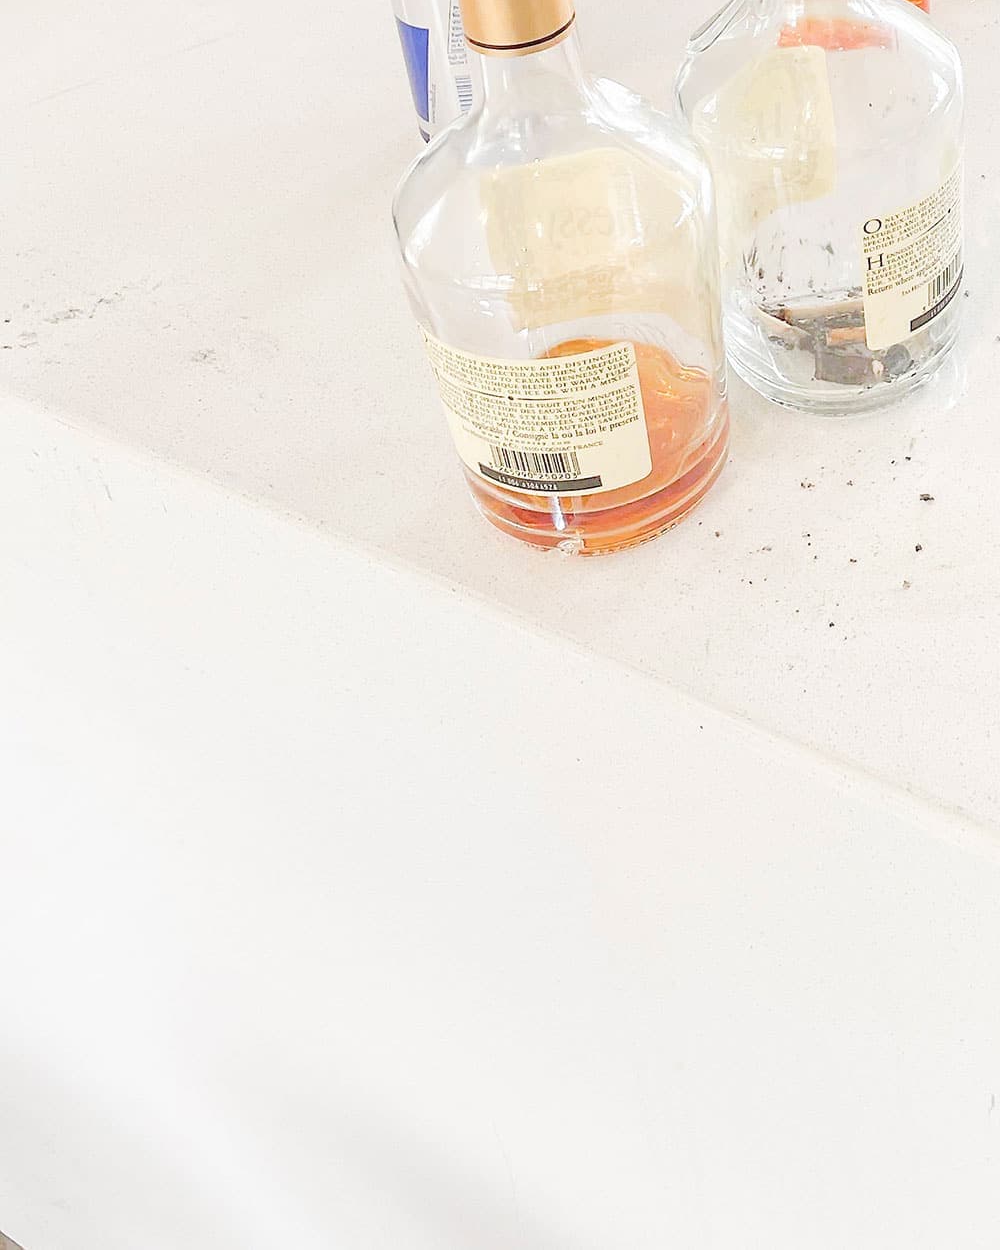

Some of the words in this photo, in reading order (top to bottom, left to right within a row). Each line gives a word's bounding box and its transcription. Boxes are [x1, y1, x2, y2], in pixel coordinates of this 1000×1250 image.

[868, 284, 894, 296] Return
[480, 362, 536, 371] EXPRESSIVE
[565, 347, 628, 368] DISTINCTIVE
[552, 368, 576, 376] THEN
[578, 354, 630, 372] CAREFULLY
[555, 369, 604, 382] HENNESSY
[607, 358, 630, 371] VERY
[522, 382, 552, 390] BLEND
[560, 385, 588, 394] WITH
[600, 372, 630, 386] MIXER
[554, 396, 636, 420] SOIGNEUSEMENT
[598, 398, 613, 406] LES
[616, 390, 636, 400] PLUS
[585, 428, 597, 436] loi
[609, 414, 639, 432] prescrit
[598, 409, 638, 426] SAVEURS
[573, 440, 604, 450] FRANCE
